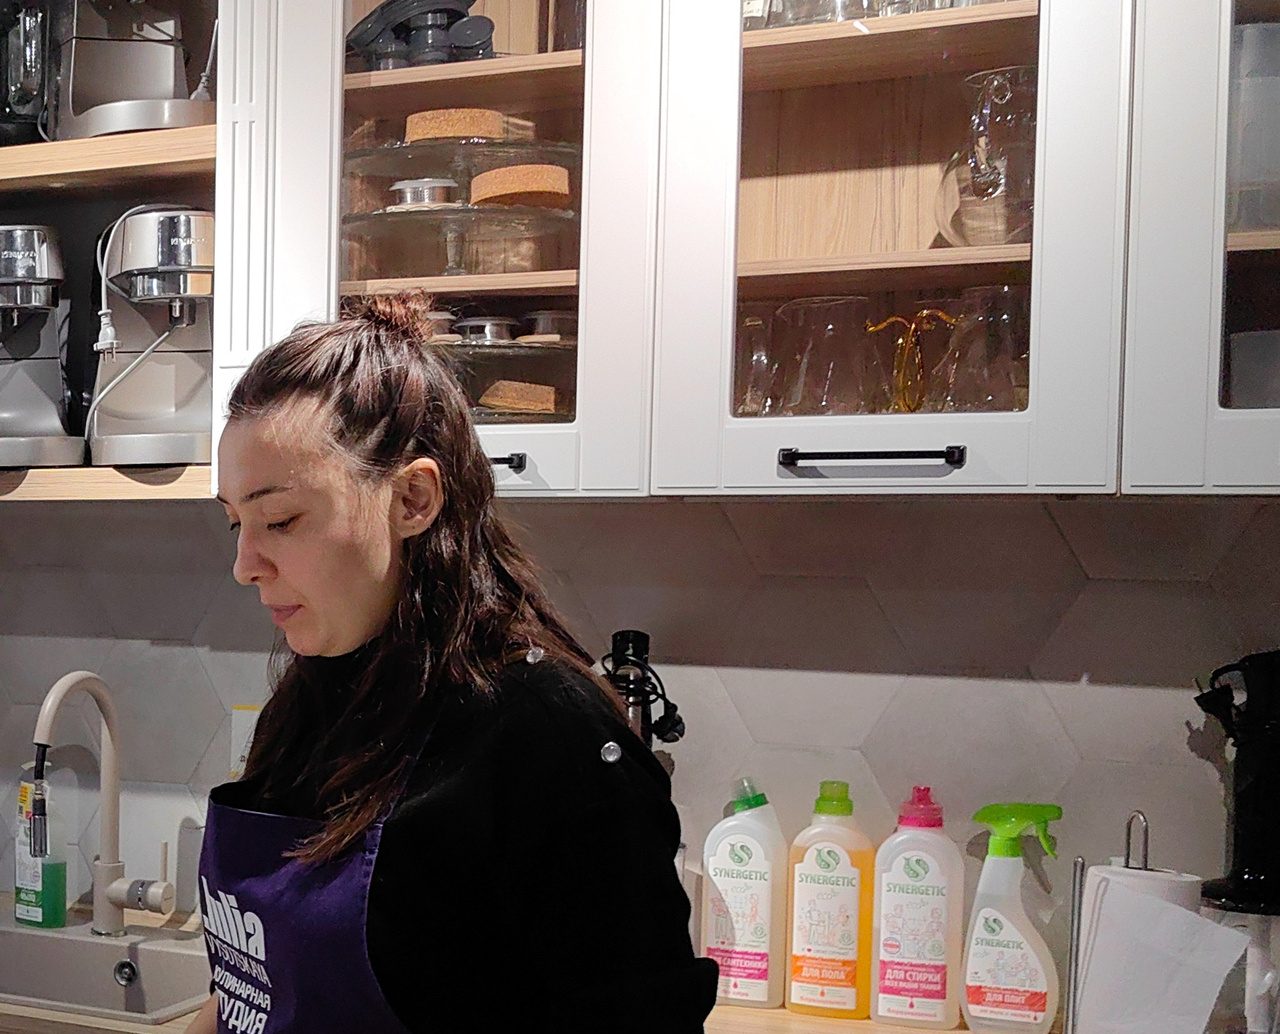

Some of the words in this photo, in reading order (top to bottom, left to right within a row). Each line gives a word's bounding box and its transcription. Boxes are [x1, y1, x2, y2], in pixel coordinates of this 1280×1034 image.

[713, 867, 769, 882] SYNERGETIC
[798, 873, 857, 888] SYNERGETIC
[886, 882, 947, 897] SYNERGETIC
[974, 937, 1025, 950] SYNERGETIC
[885, 969, 905, 980] ДЛЯ
[906, 971, 941, 982] СТИРКИ
